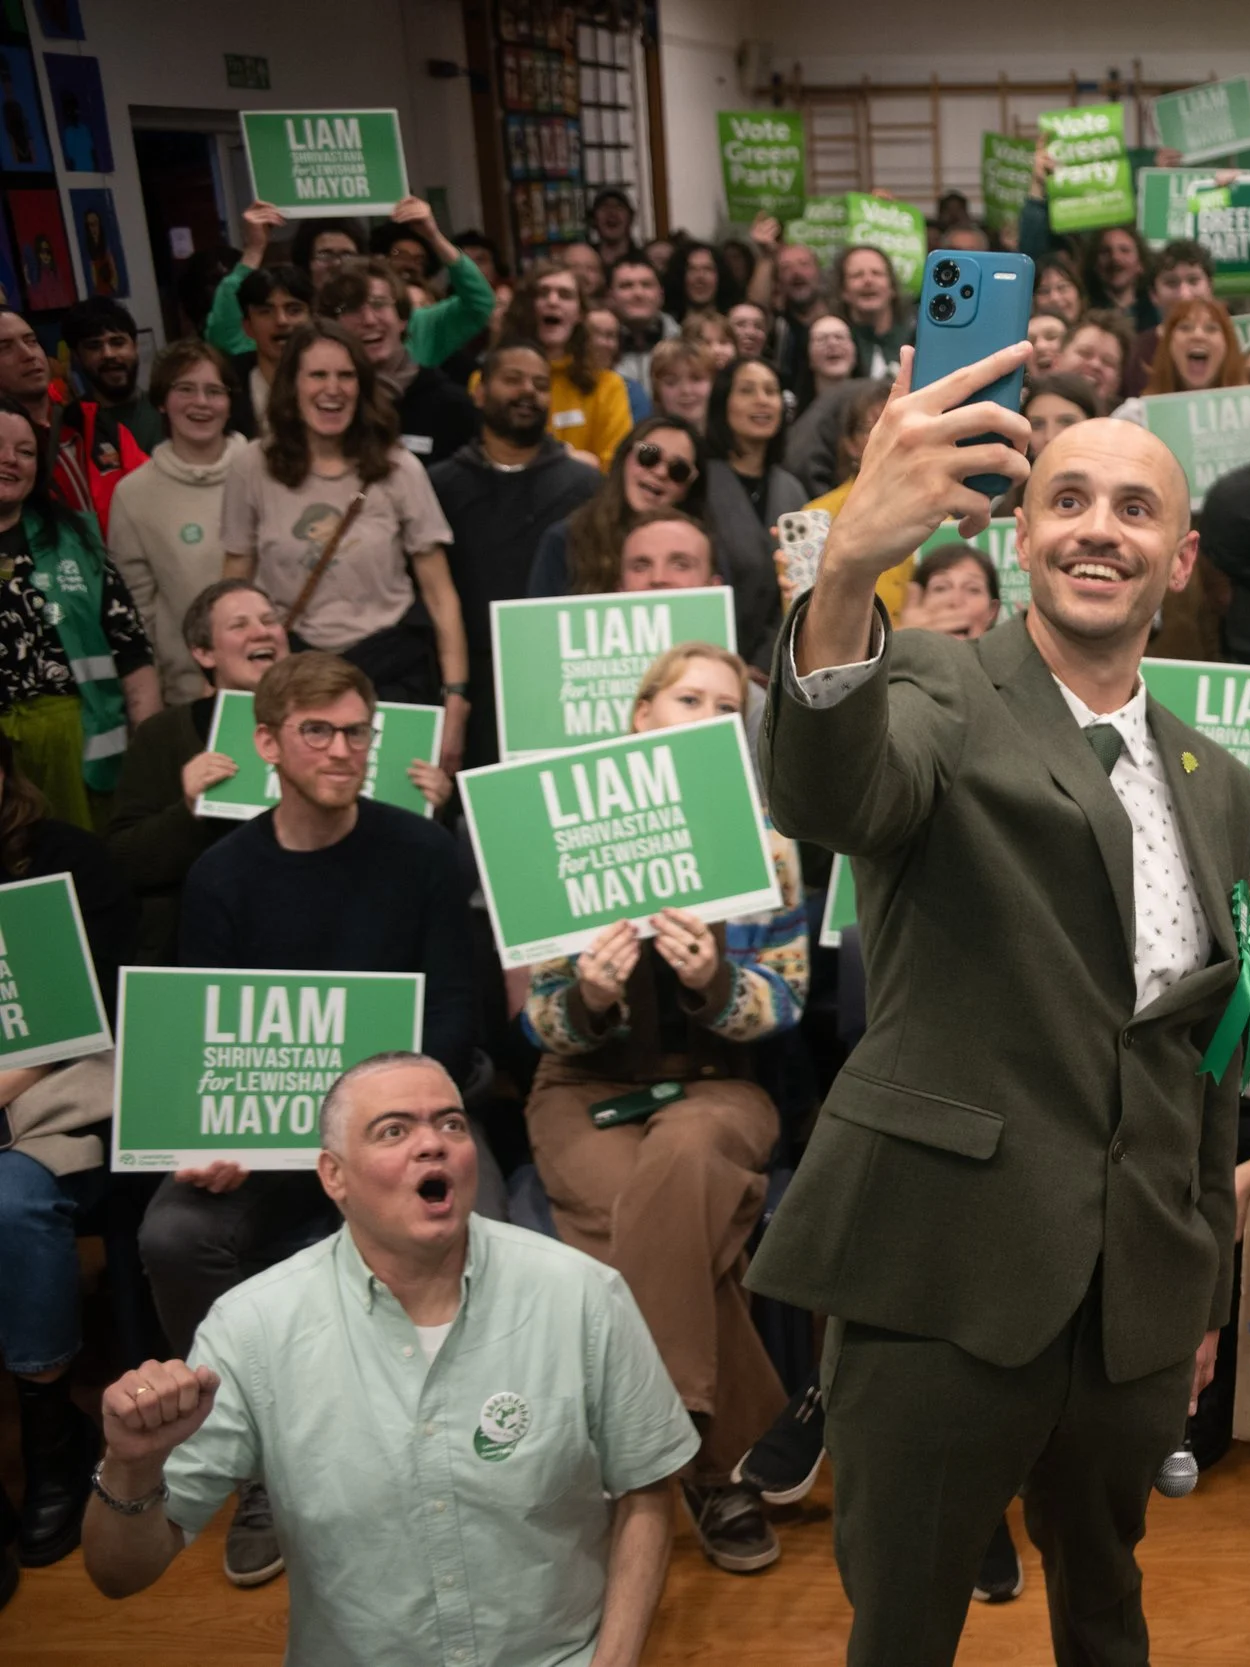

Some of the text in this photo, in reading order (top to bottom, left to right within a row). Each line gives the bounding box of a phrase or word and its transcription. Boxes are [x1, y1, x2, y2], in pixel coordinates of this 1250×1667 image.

[285, 118, 363, 150] LIAM
[729, 117, 791, 142] Vote
[1051, 111, 1110, 138] Vote
[724, 141, 800, 163] Green
[1047, 136, 1121, 163] Green
[295, 175, 371, 199] MAYOR
[729, 164, 796, 192] Party
[1054, 158, 1119, 188] Party
[859, 199, 915, 230] Vote
[853, 220, 923, 253] Green
[557, 604, 672, 660] LIAM
[558, 680, 589, 702] for
[562, 698, 632, 737] MAY
[539, 745, 683, 829] LIAM
[553, 806, 687, 852] SHRIVASTAVA
[558, 828, 693, 878] for LEWISHAM
[565, 852, 703, 918] MAYOR
[204, 984, 347, 1044] LIAM
[203, 1046, 342, 1069] SHRIVASTAVA
[196, 1070, 234, 1095] for
[200, 1095, 321, 1135] MAYO
